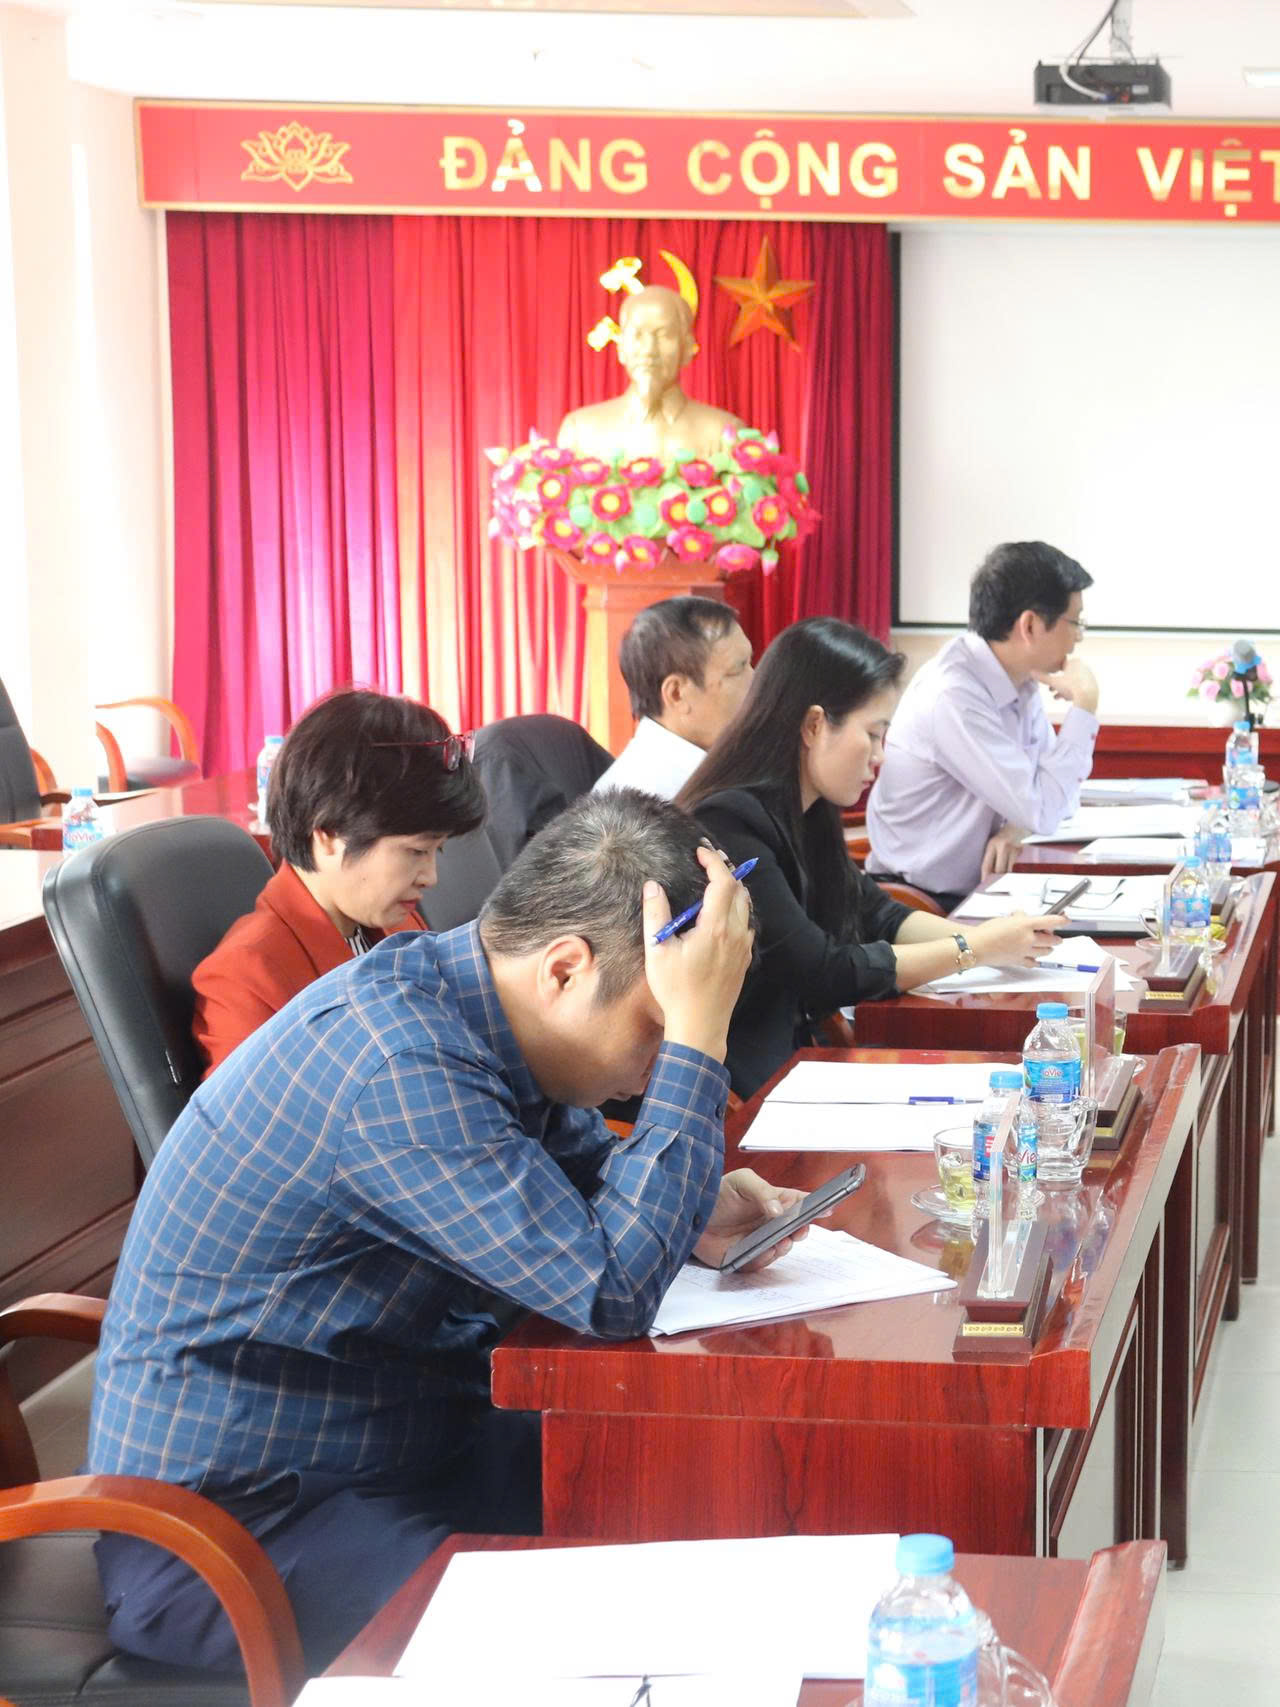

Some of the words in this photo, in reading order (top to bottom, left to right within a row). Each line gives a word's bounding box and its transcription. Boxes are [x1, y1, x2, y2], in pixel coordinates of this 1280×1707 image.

[438, 118, 648, 194] ĐẢNG
[687, 128, 898, 210] CỘNG
[942, 127, 1092, 201] SẢN
